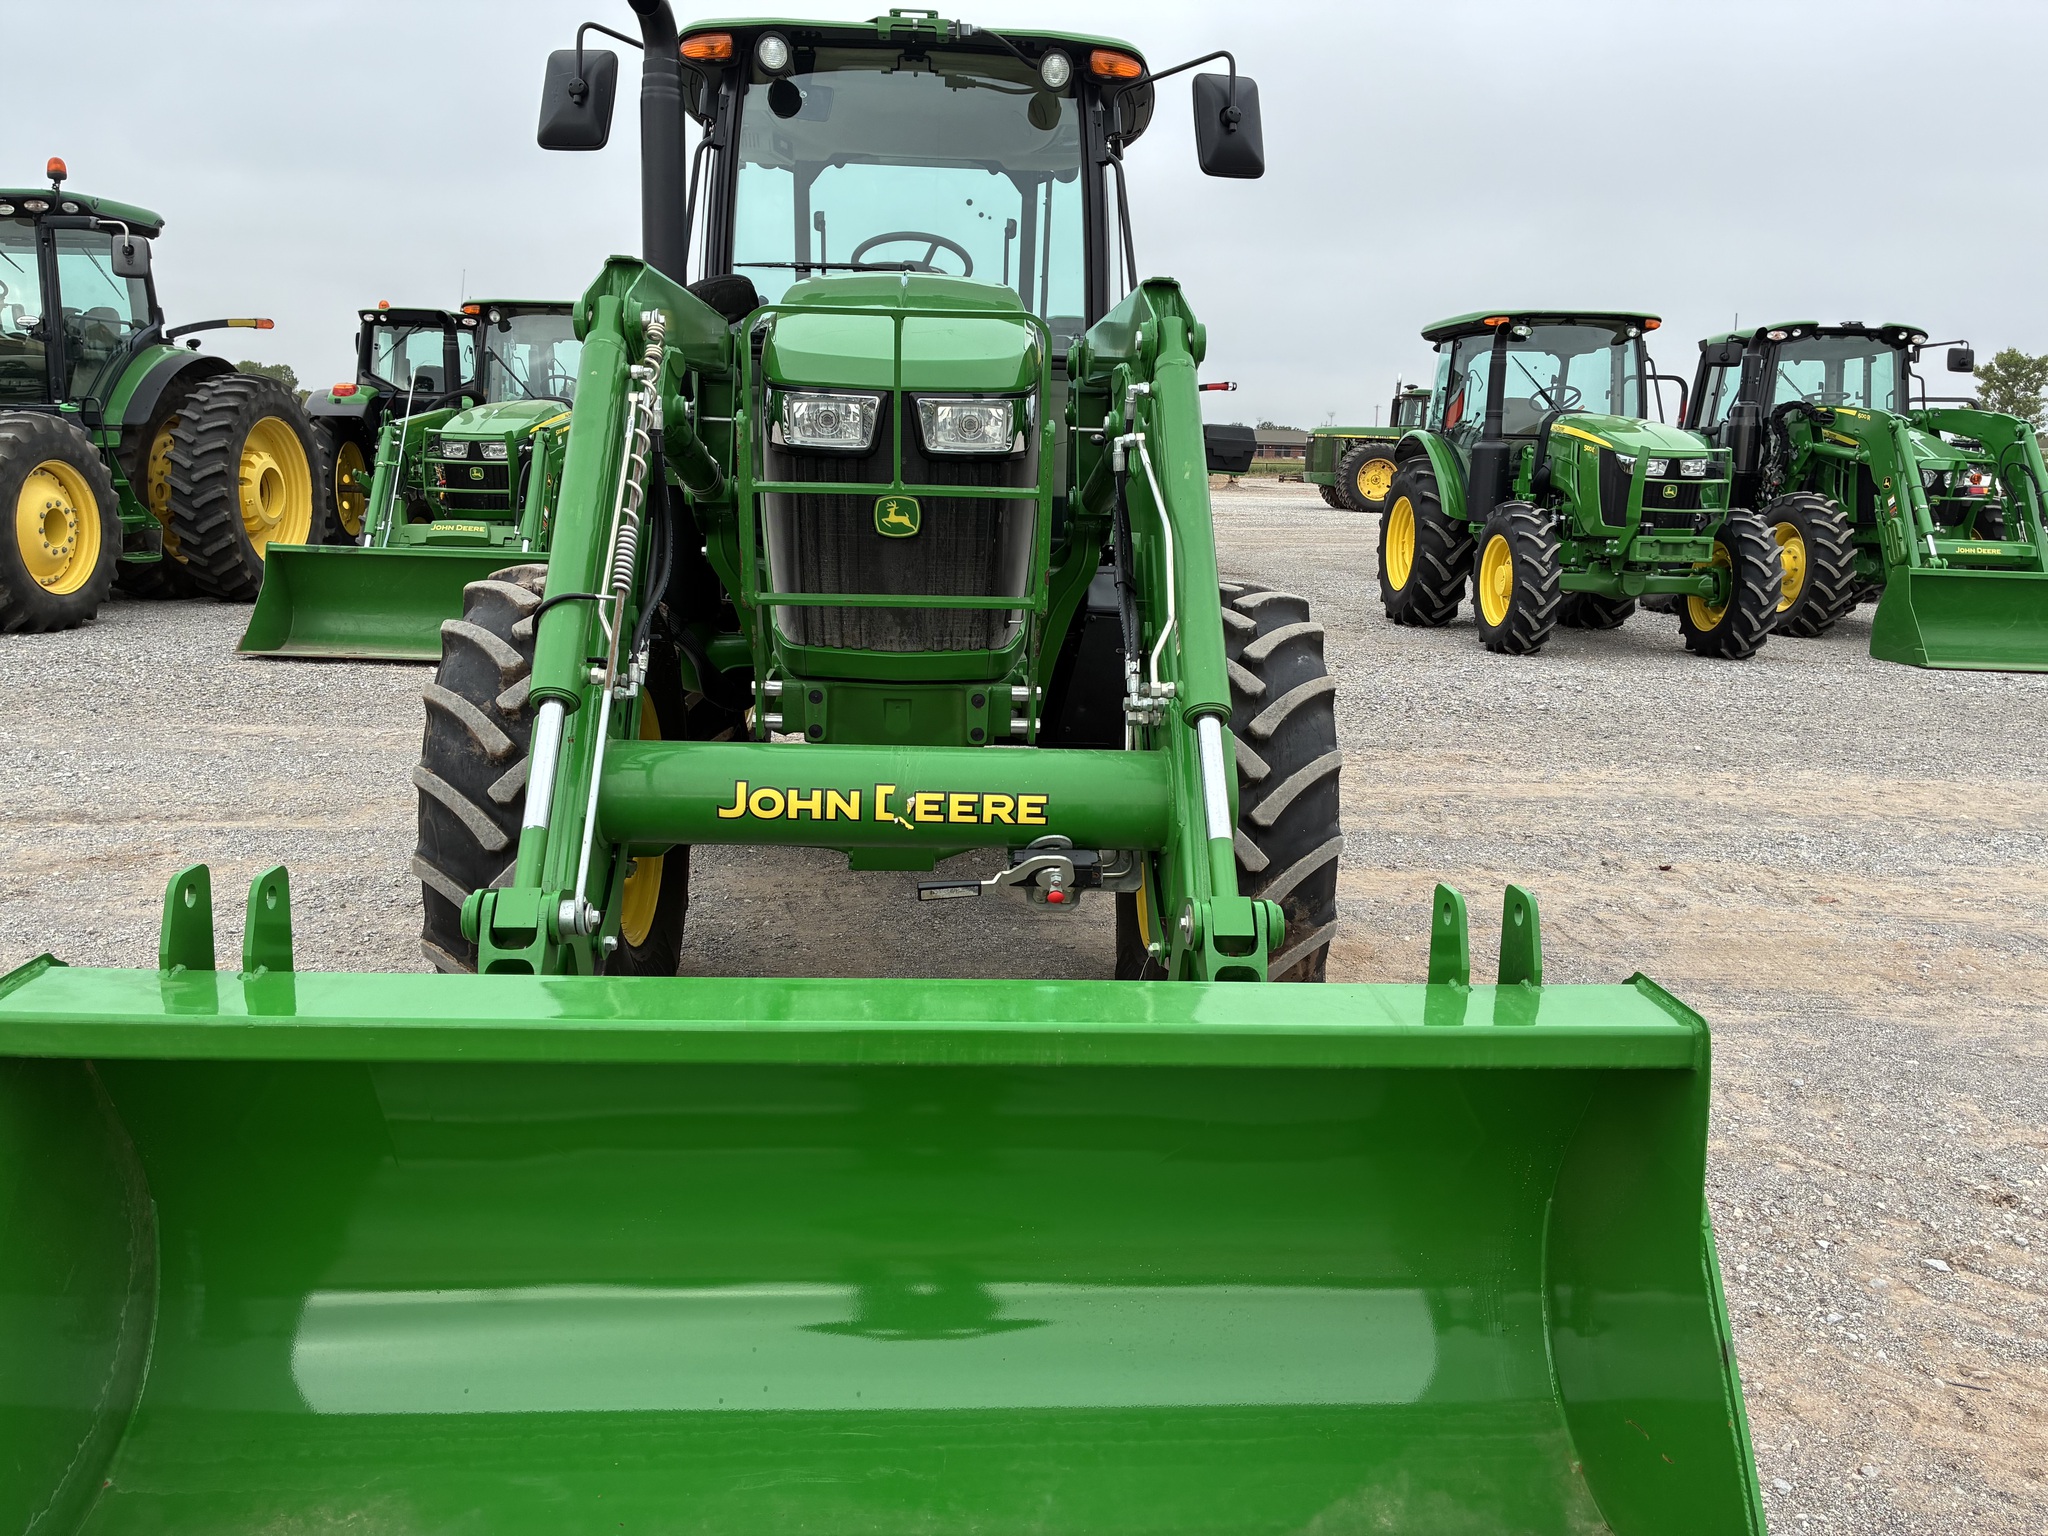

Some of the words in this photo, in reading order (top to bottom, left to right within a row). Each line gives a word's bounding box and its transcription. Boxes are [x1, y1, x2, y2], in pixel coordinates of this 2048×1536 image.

[456, 524, 485, 532] DEERE
[1977, 547, 2001, 555] DEERE
[717, 780, 862, 821] JOHN
